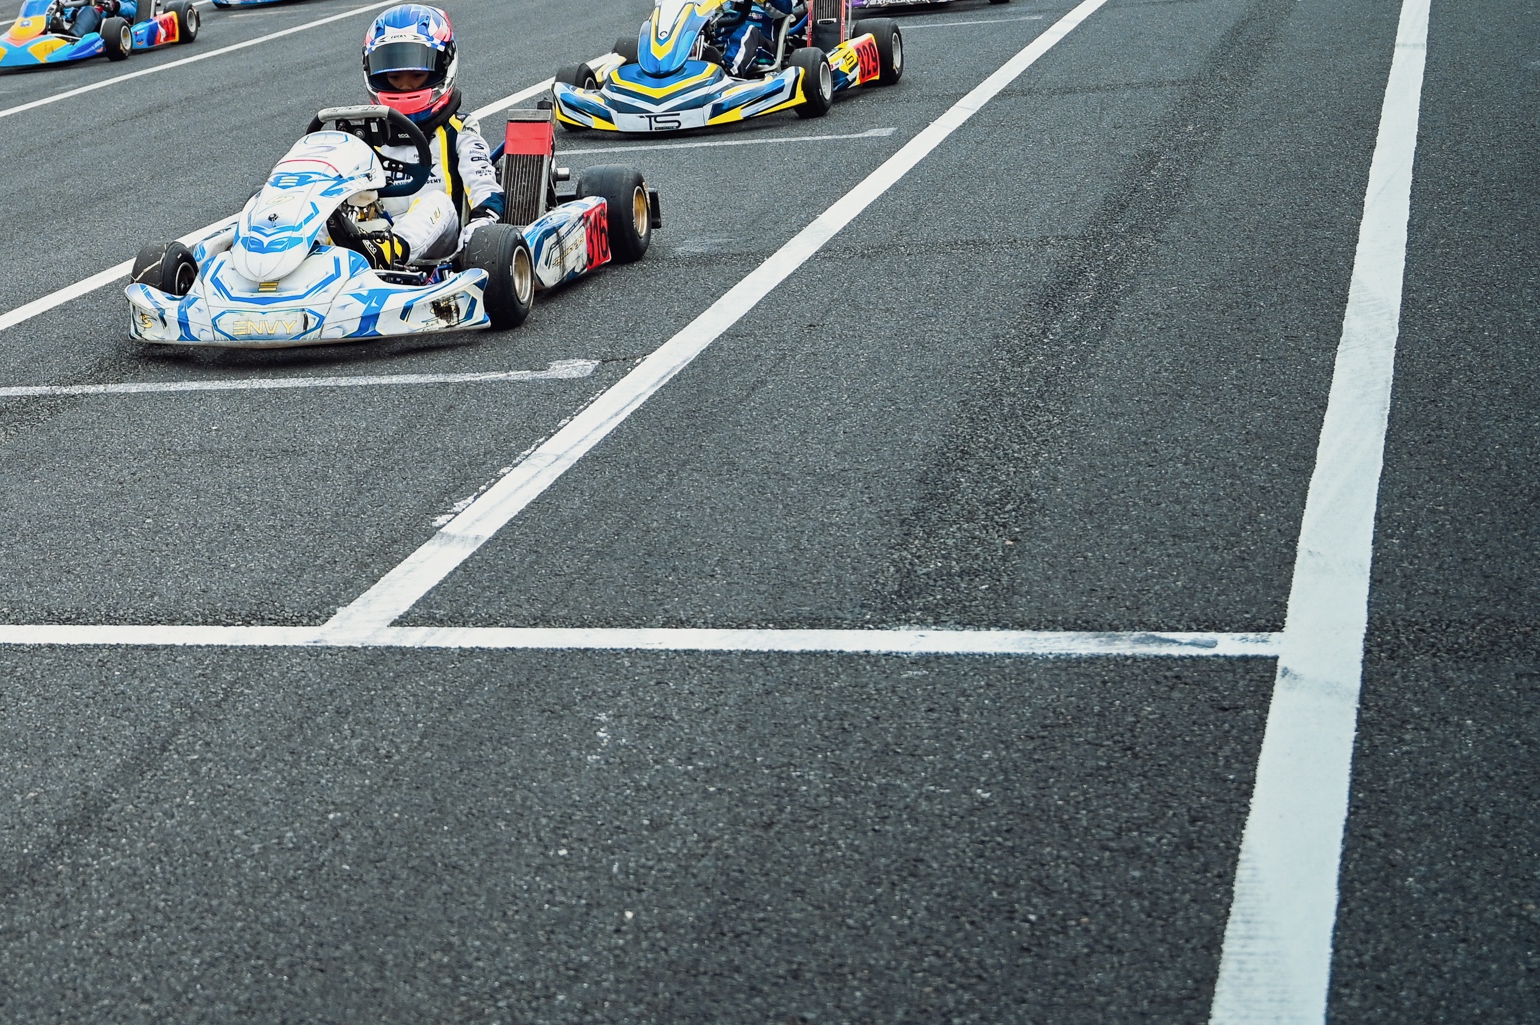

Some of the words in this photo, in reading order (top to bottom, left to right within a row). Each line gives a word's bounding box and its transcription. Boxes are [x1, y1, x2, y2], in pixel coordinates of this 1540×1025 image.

[856, 41, 879, 79] 329
[585, 207, 609, 267] 316
[233, 320, 297, 336] ENVY
